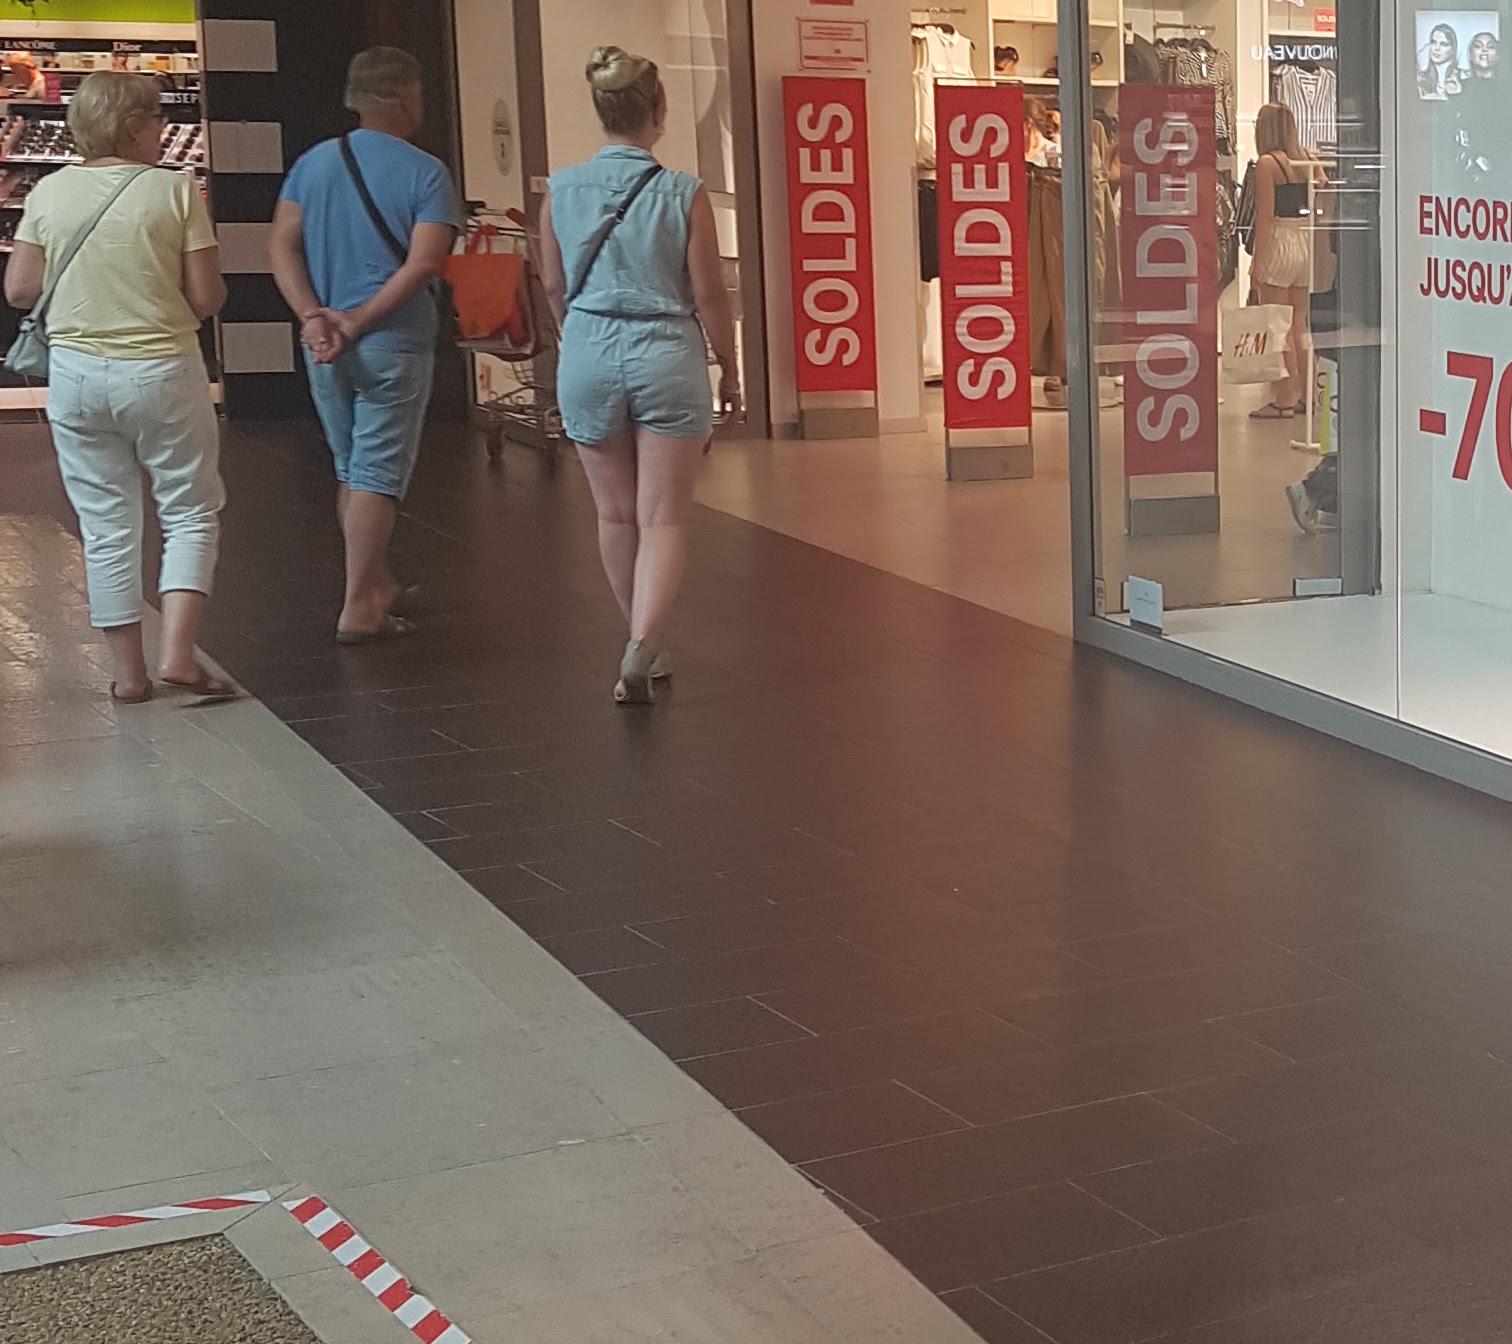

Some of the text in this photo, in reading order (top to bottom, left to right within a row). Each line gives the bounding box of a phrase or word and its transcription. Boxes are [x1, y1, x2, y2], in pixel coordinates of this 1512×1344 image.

[112, 41, 142, 52] Dior
[797, 102, 861, 367] SOLDES
[948, 112, 1018, 401] SOLDES
[1133, 116, 1200, 443] SOLDES
